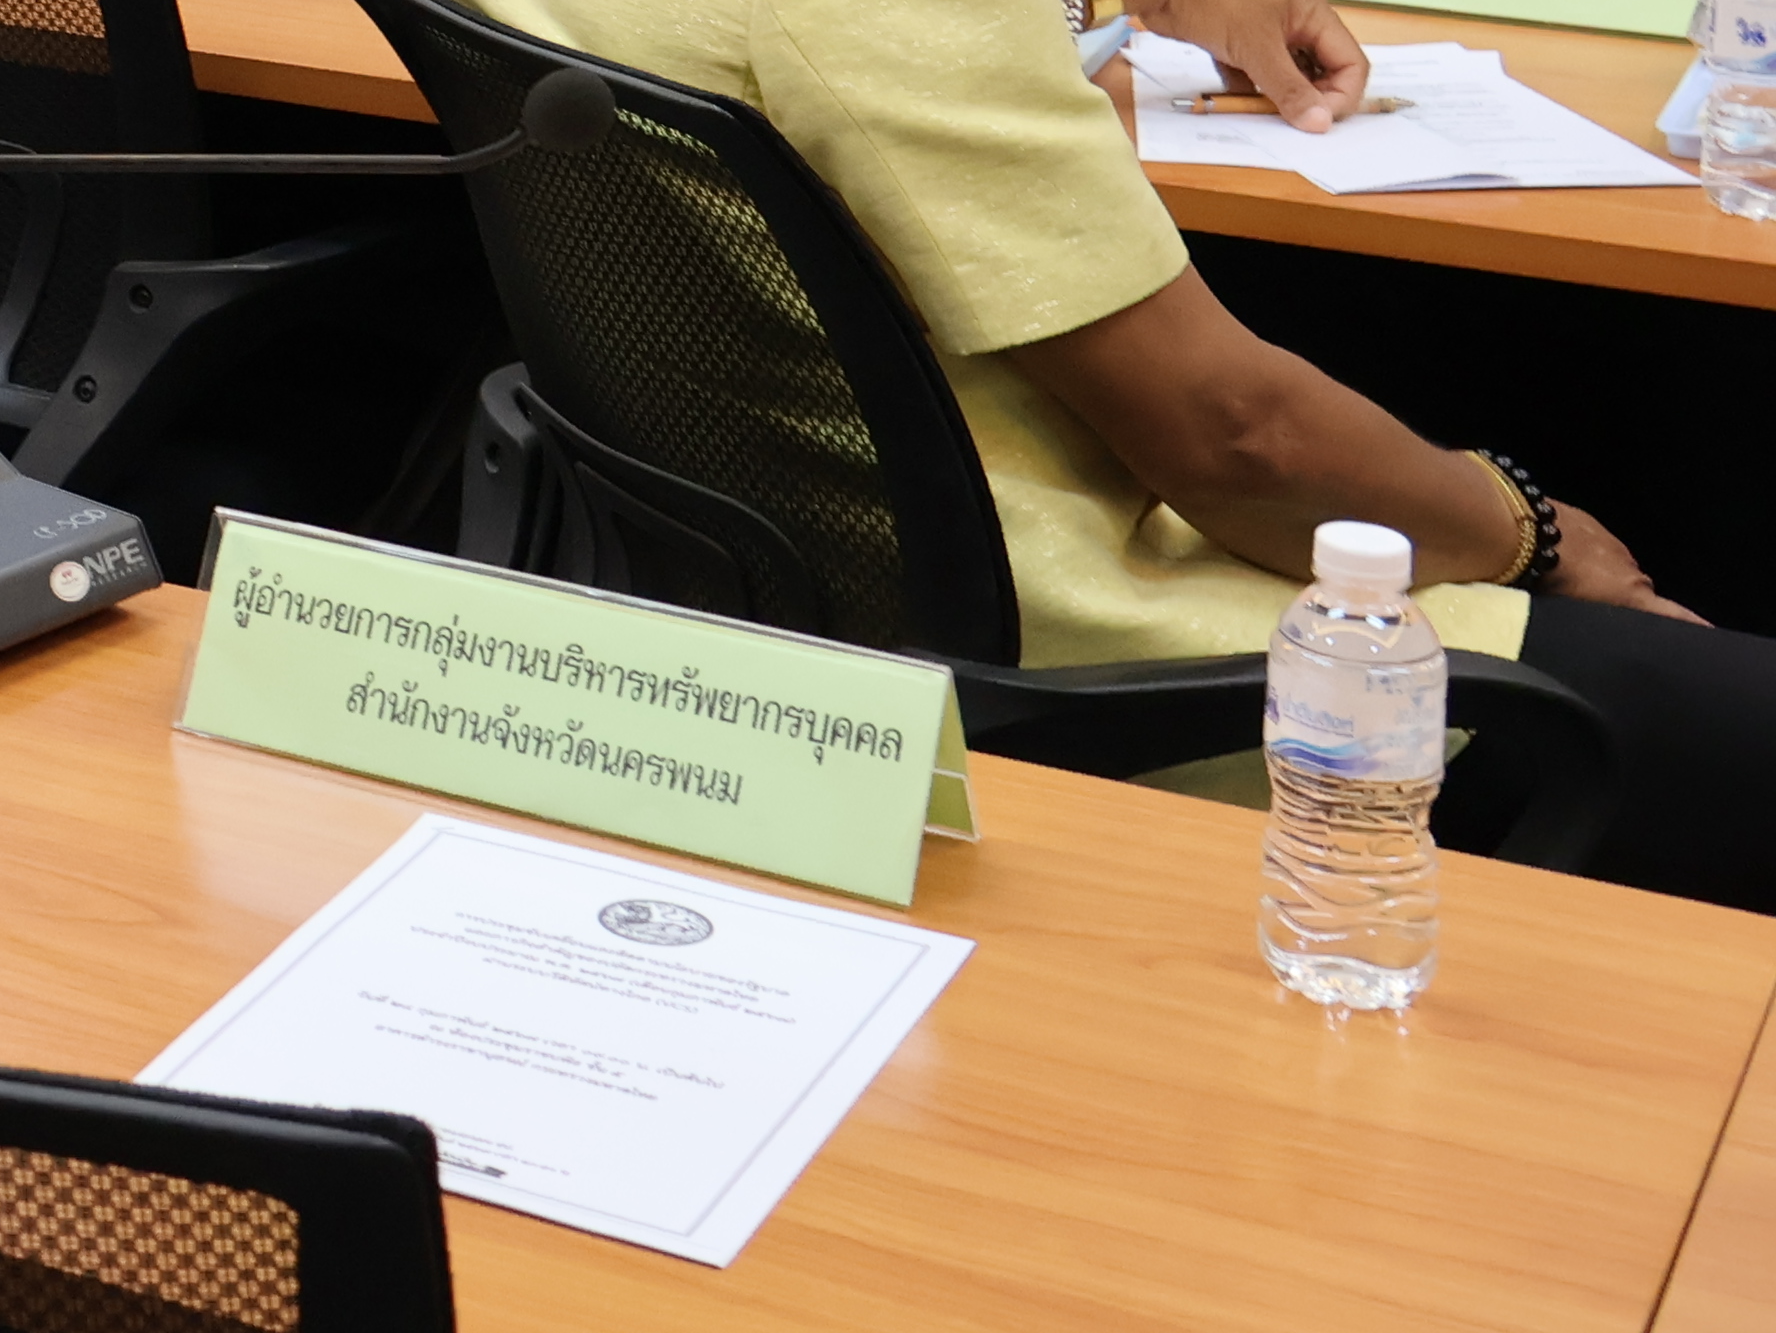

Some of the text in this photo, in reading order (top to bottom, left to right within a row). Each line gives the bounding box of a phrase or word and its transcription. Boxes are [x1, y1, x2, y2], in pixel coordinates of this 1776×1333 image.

[82, 537, 145, 579] NPE
[231, 567, 904, 767] ผู้อำนวยการกลุ่มงานบริหารทรัพยากรบุคคล
[346, 675, 744, 807] สำนักงานจังหวัดนครพนม
